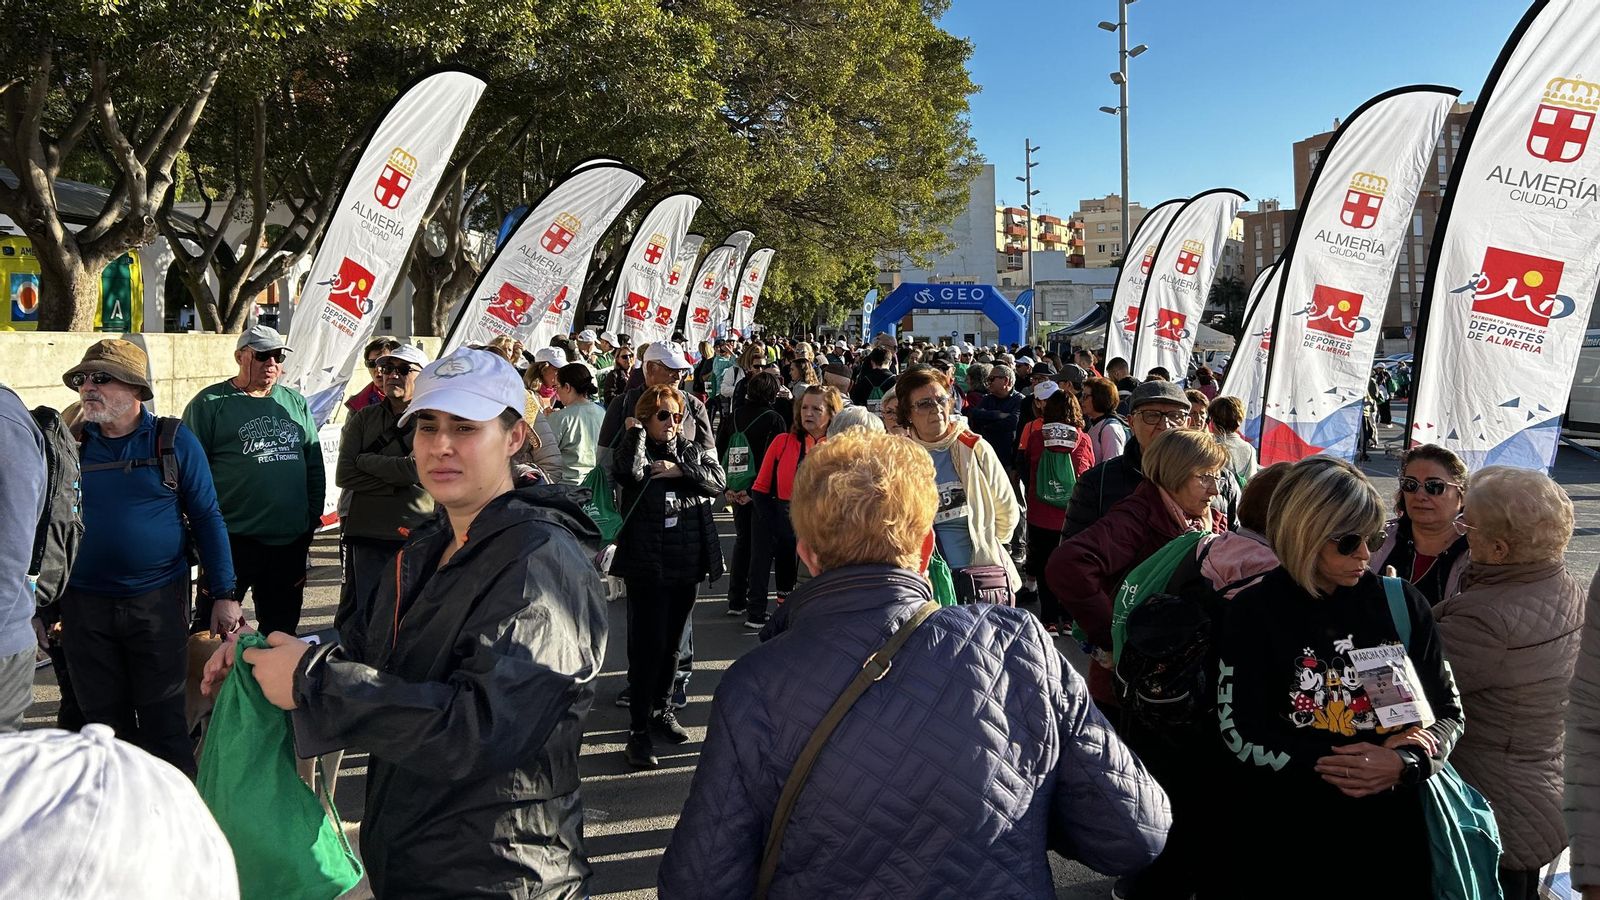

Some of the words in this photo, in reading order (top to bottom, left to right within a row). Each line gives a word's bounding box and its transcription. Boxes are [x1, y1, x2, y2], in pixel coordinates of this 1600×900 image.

[1486, 165, 1598, 202] ALMERÍA
[1509, 189, 1568, 210] CIUDAD
[351, 201, 404, 240] ALMERÍA
[361, 220, 389, 241] CIUDAD
[1314, 229, 1385, 256] ALMERÍA
[1329, 245, 1366, 261] CIUDAD
[517, 244, 564, 275] ALMERÍA
[1160, 274, 1201, 292] ALMERÍA
[941, 288, 984, 301] GEO
[321, 313, 330, 323] DE
[331, 319, 355, 338] ALMERIA
[324, 306, 358, 331] DEPORTES
[482, 316, 514, 336] DEPORTES
[1471, 314, 1504, 325] PATRONATO
[1506, 322, 1536, 333] MUNICIPAL
[1305, 333, 1352, 350] DEPORTES
[1467, 331, 1484, 341] DE
[1485, 335, 1542, 354] ALMERIA
[1469, 320, 1545, 344] DEPORTES
[1303, 340, 1314, 349] DE
[1316, 344, 1350, 357] ALMERIA
[238, 415, 298, 441] CHICAGO
[1050, 429, 1068, 438] 323
[243, 438, 277, 455] Urban
[1353, 651, 1380, 662] MARCHA
[1217, 658, 1291, 771] MICKEY
